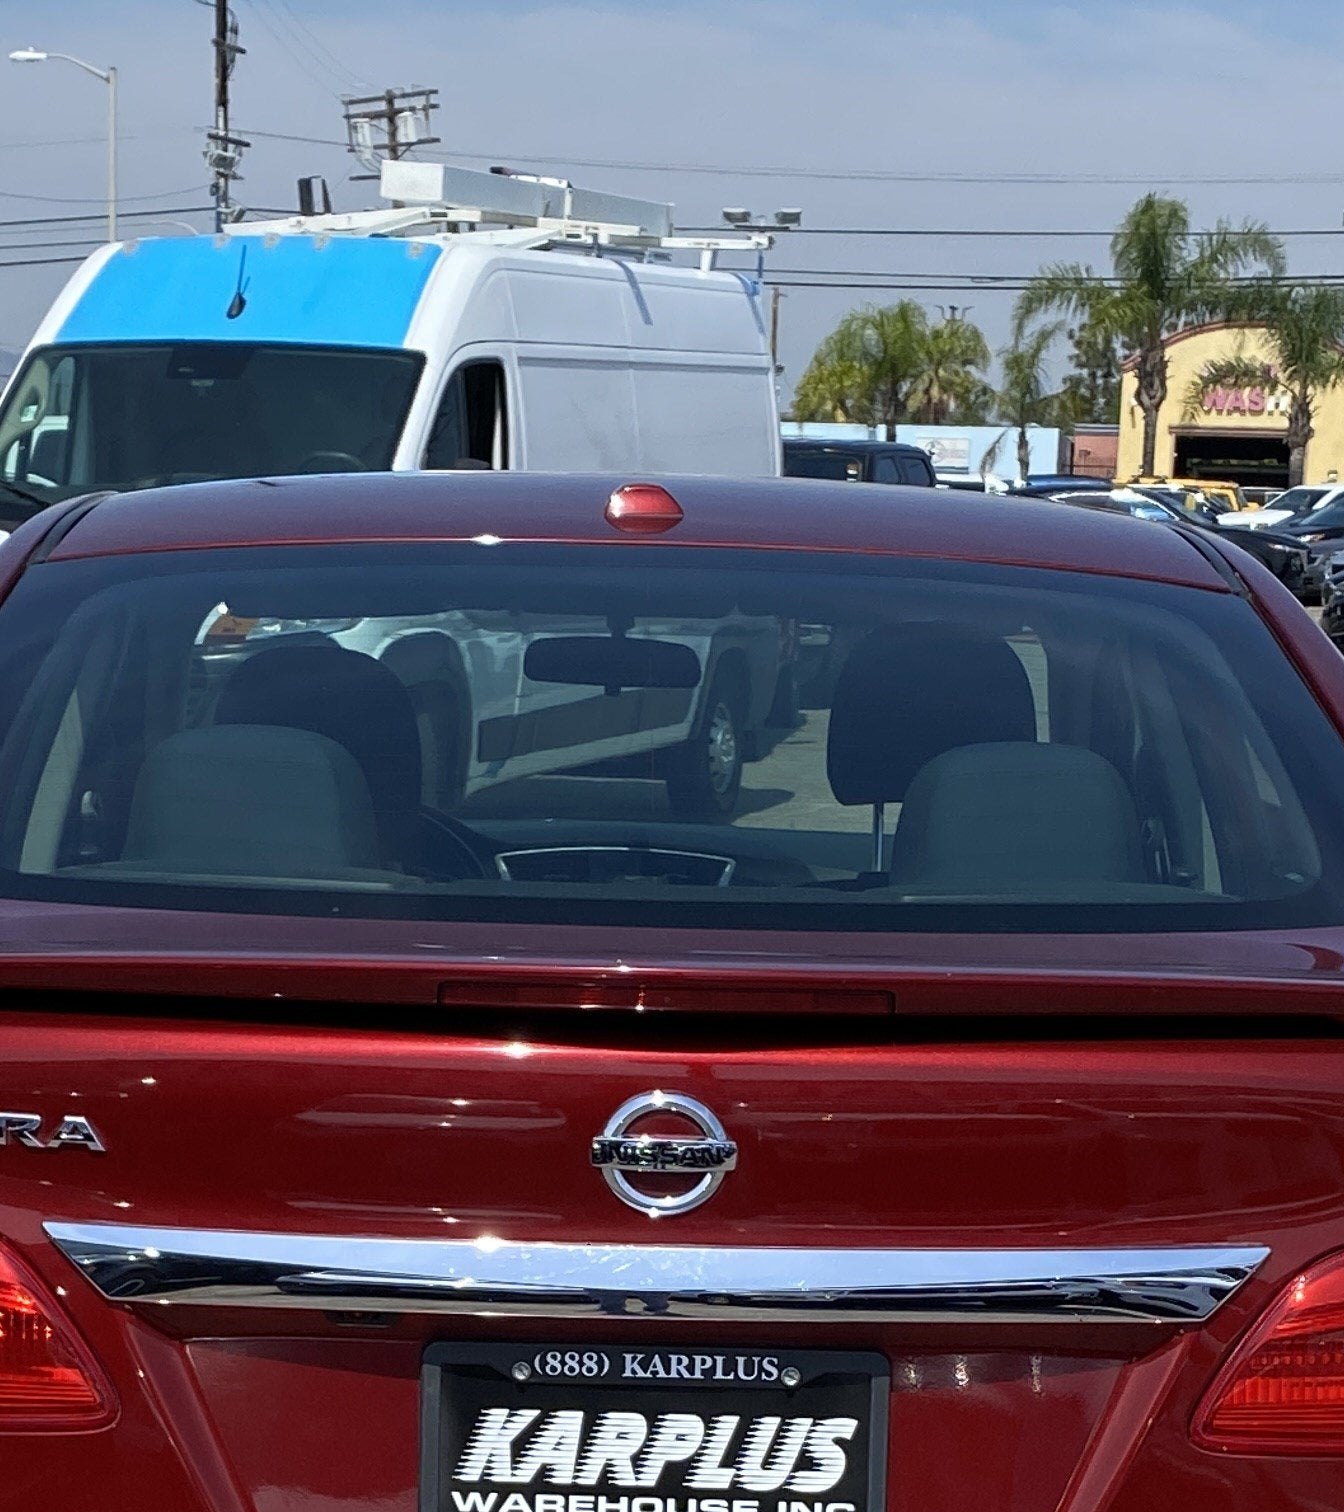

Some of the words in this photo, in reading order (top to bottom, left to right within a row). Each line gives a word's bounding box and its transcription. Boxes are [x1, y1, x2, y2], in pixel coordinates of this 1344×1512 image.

[602, 1142, 726, 1166] NISSAN
[533, 1351, 610, 1378] (888)
[621, 1353, 780, 1382] KARPLUS
[452, 1407, 859, 1494] KARPLUS
